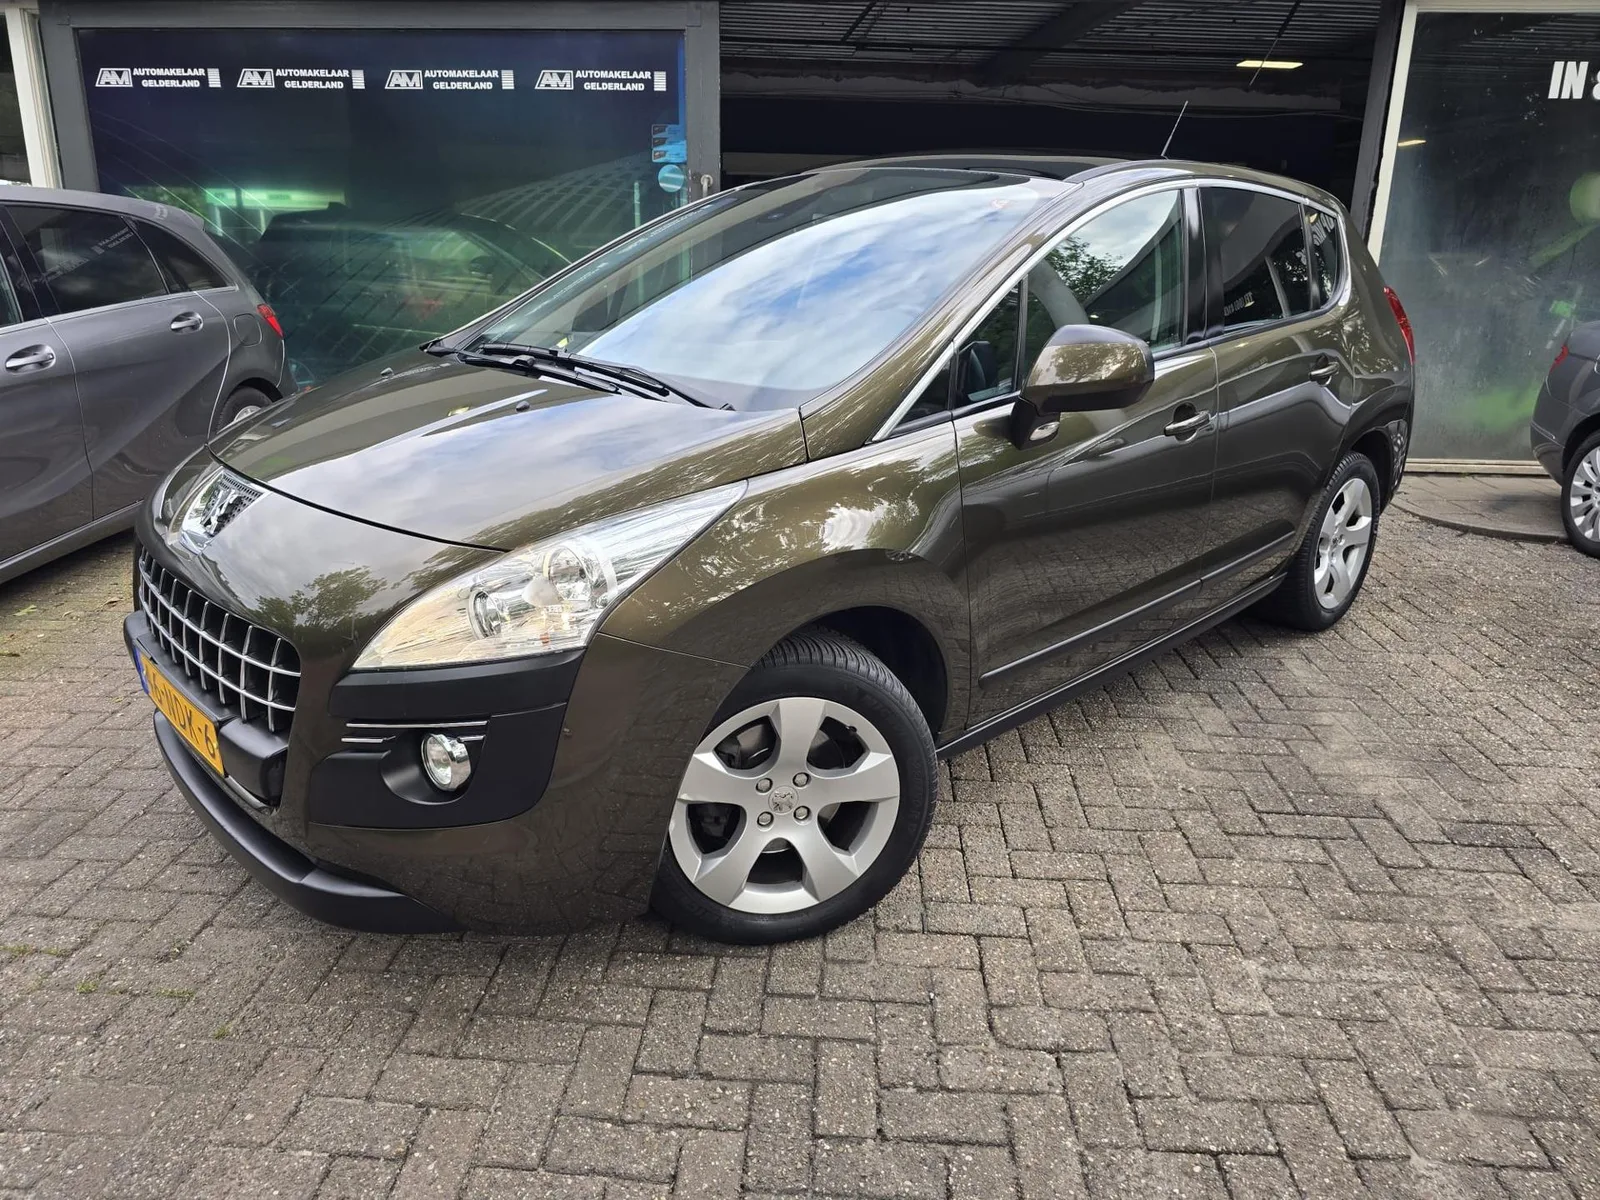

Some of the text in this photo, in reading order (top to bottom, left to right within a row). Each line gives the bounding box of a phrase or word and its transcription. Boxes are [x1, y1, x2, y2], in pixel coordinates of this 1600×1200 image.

[98, 69, 131, 86] AM
[133, 68, 206, 77] AUTOMAKELAAR
[276, 69, 350, 78] AUTOMAKELAAR
[424, 70, 500, 79] AUTOMAKELAAR
[575, 70, 652, 80] AUTOMAKELAAR
[239, 70, 272, 86] AM
[387, 71, 421, 88] AM
[538, 71, 571, 88] AM
[1548, 61, 1589, 99] IN
[142, 80, 201, 88] GELDERLAND
[284, 81, 344, 89] GELDERLAND
[433, 82, 494, 90] GELDERLAND
[584, 82, 645, 92] GELDERLAND
